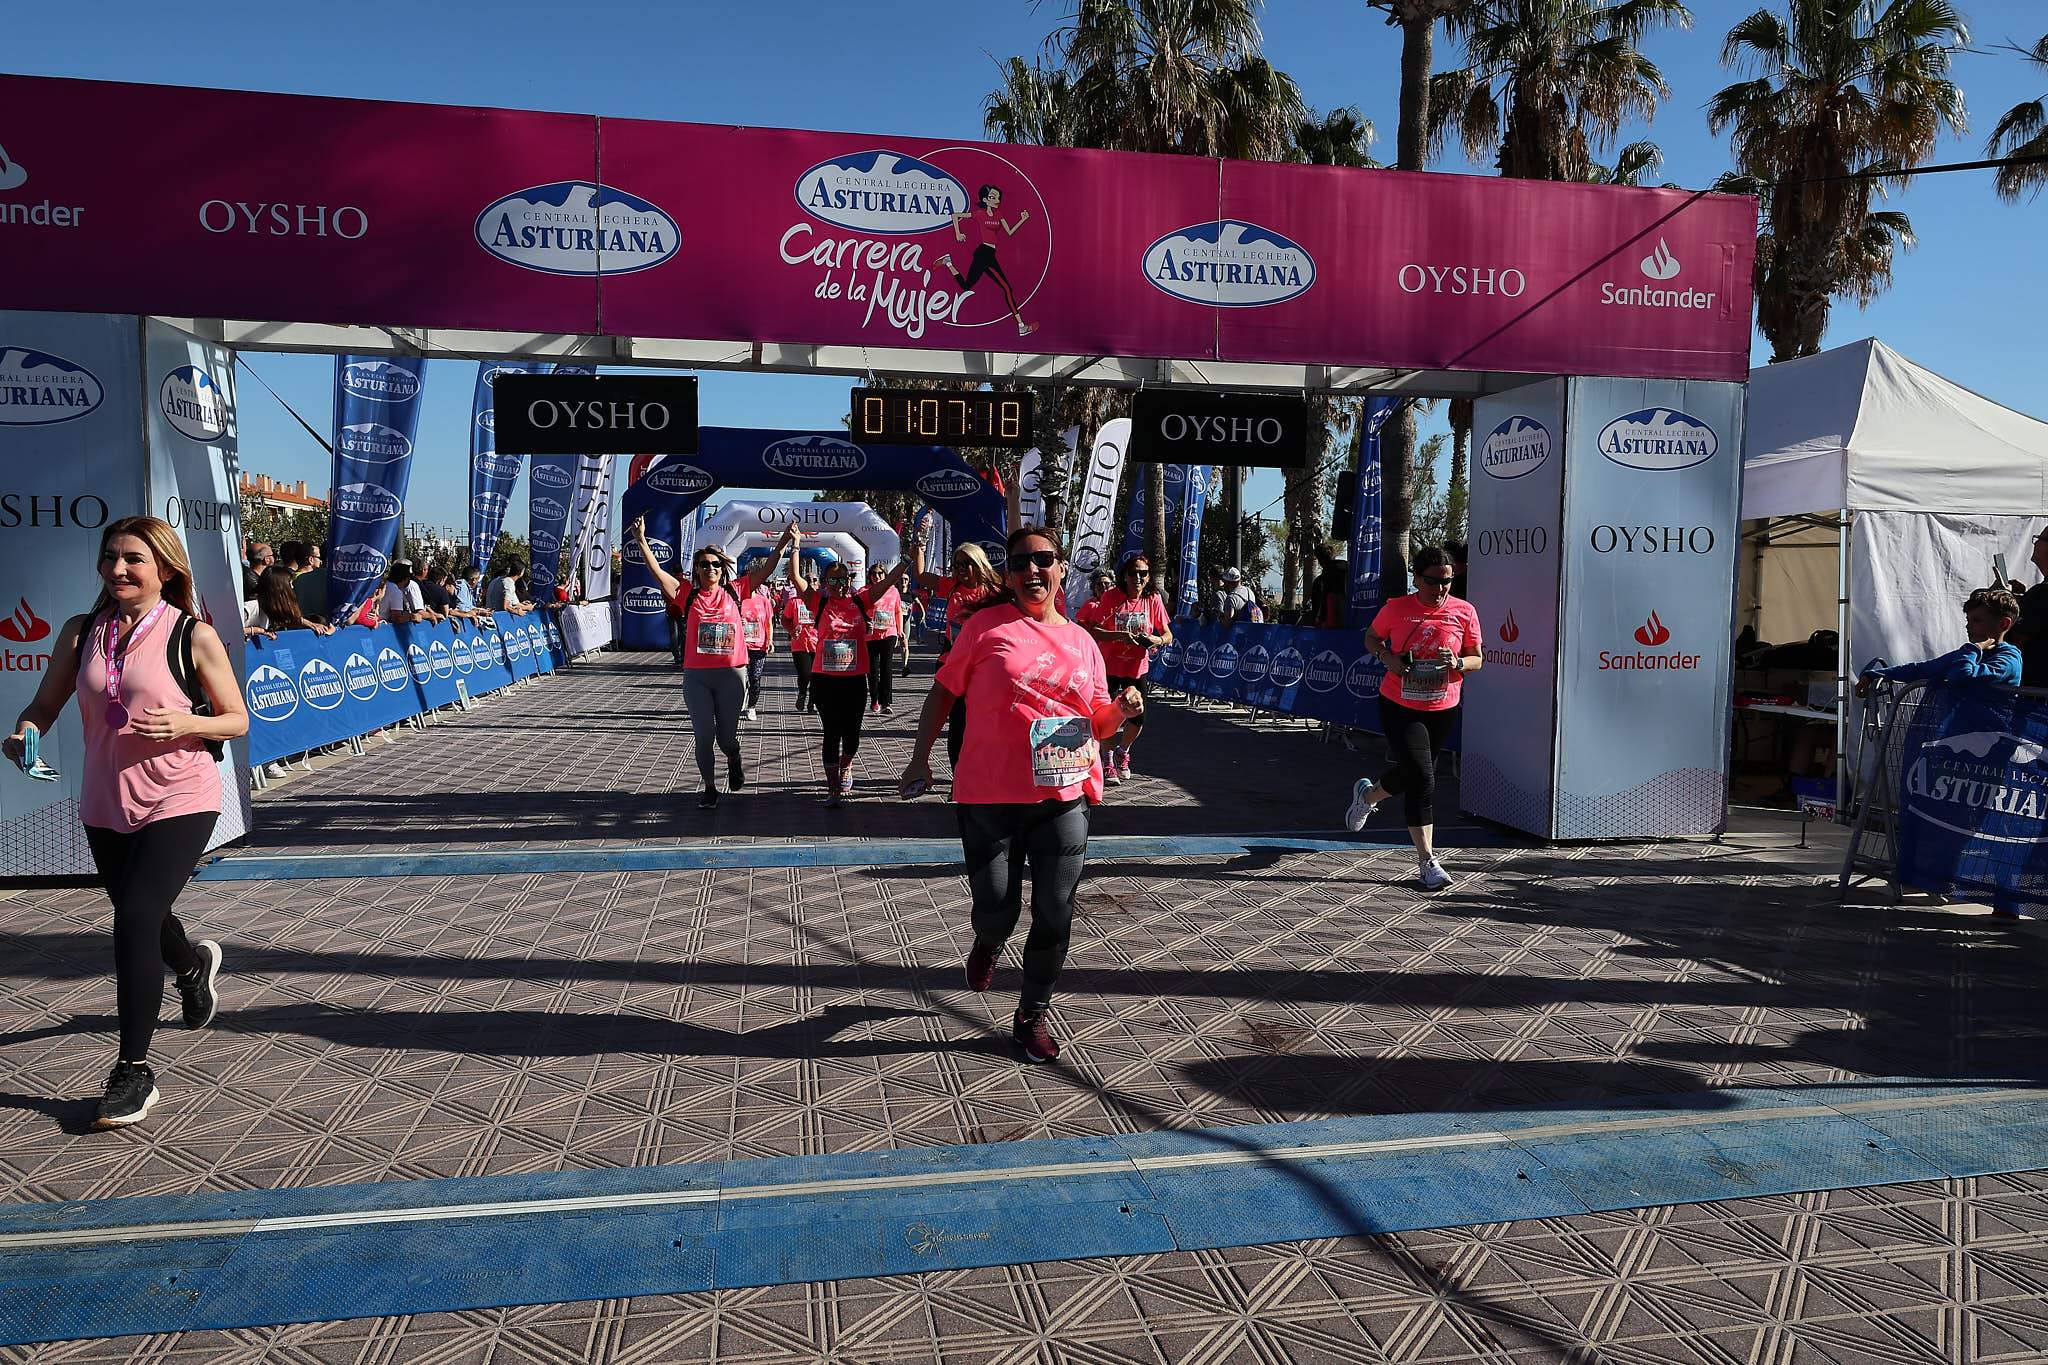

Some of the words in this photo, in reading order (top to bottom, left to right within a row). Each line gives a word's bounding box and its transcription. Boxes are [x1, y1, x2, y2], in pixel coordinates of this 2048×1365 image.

[809, 177, 954, 215] ASTURIANA
[836, 177, 891, 187] CENTRAL
[896, 180, 951, 191] LECHERA
[199, 200, 369, 239] OYSHO
[523, 212, 588, 223] CENTRAL
[491, 212, 665, 253] ASTURIANA
[779, 223, 923, 272] Carrera
[1183, 248, 1237, 258] CENTRAL
[1242, 251, 1297, 262] LECHERA
[1156, 248, 1302, 287] ASTURIANA
[1398, 264, 1526, 297] OYSHO
[815, 270, 841, 299] de
[847, 271, 866, 301] la
[862, 269, 976, 338] Mujer
[1601, 282, 1715, 309] Santander
[27, 375, 84, 384] LECHERA
[344, 370, 414, 395] ASTURIANA
[527, 399, 669, 431] OYSHO
[1161, 413, 1283, 445] OYSHO
[1606, 429, 1709, 456] ASTURIANA
[1625, 428, 1663, 436] CENTRAL
[770, 447, 859, 468] ASTURIANA
[1484, 440, 1545, 467] ASTURIANA
[651, 474, 708, 487] ASTURIANA
[921, 480, 977, 493] ASTURIANA
[166, 496, 232, 533] OYSHO
[758, 507, 839, 525] OYSHO
[1074, 442, 1121, 574] OYSHO
[1478, 526, 1547, 555] OYSHO
[1591, 525, 1715, 554] OYSHO
[1599, 651, 1701, 670] Santander
[303, 680, 343, 700] ASTURIANA
[346, 672, 378, 691] ASTURIANA
[251, 689, 297, 711] ASTURIANA
[1943, 759, 2006, 779] CENTRAL
